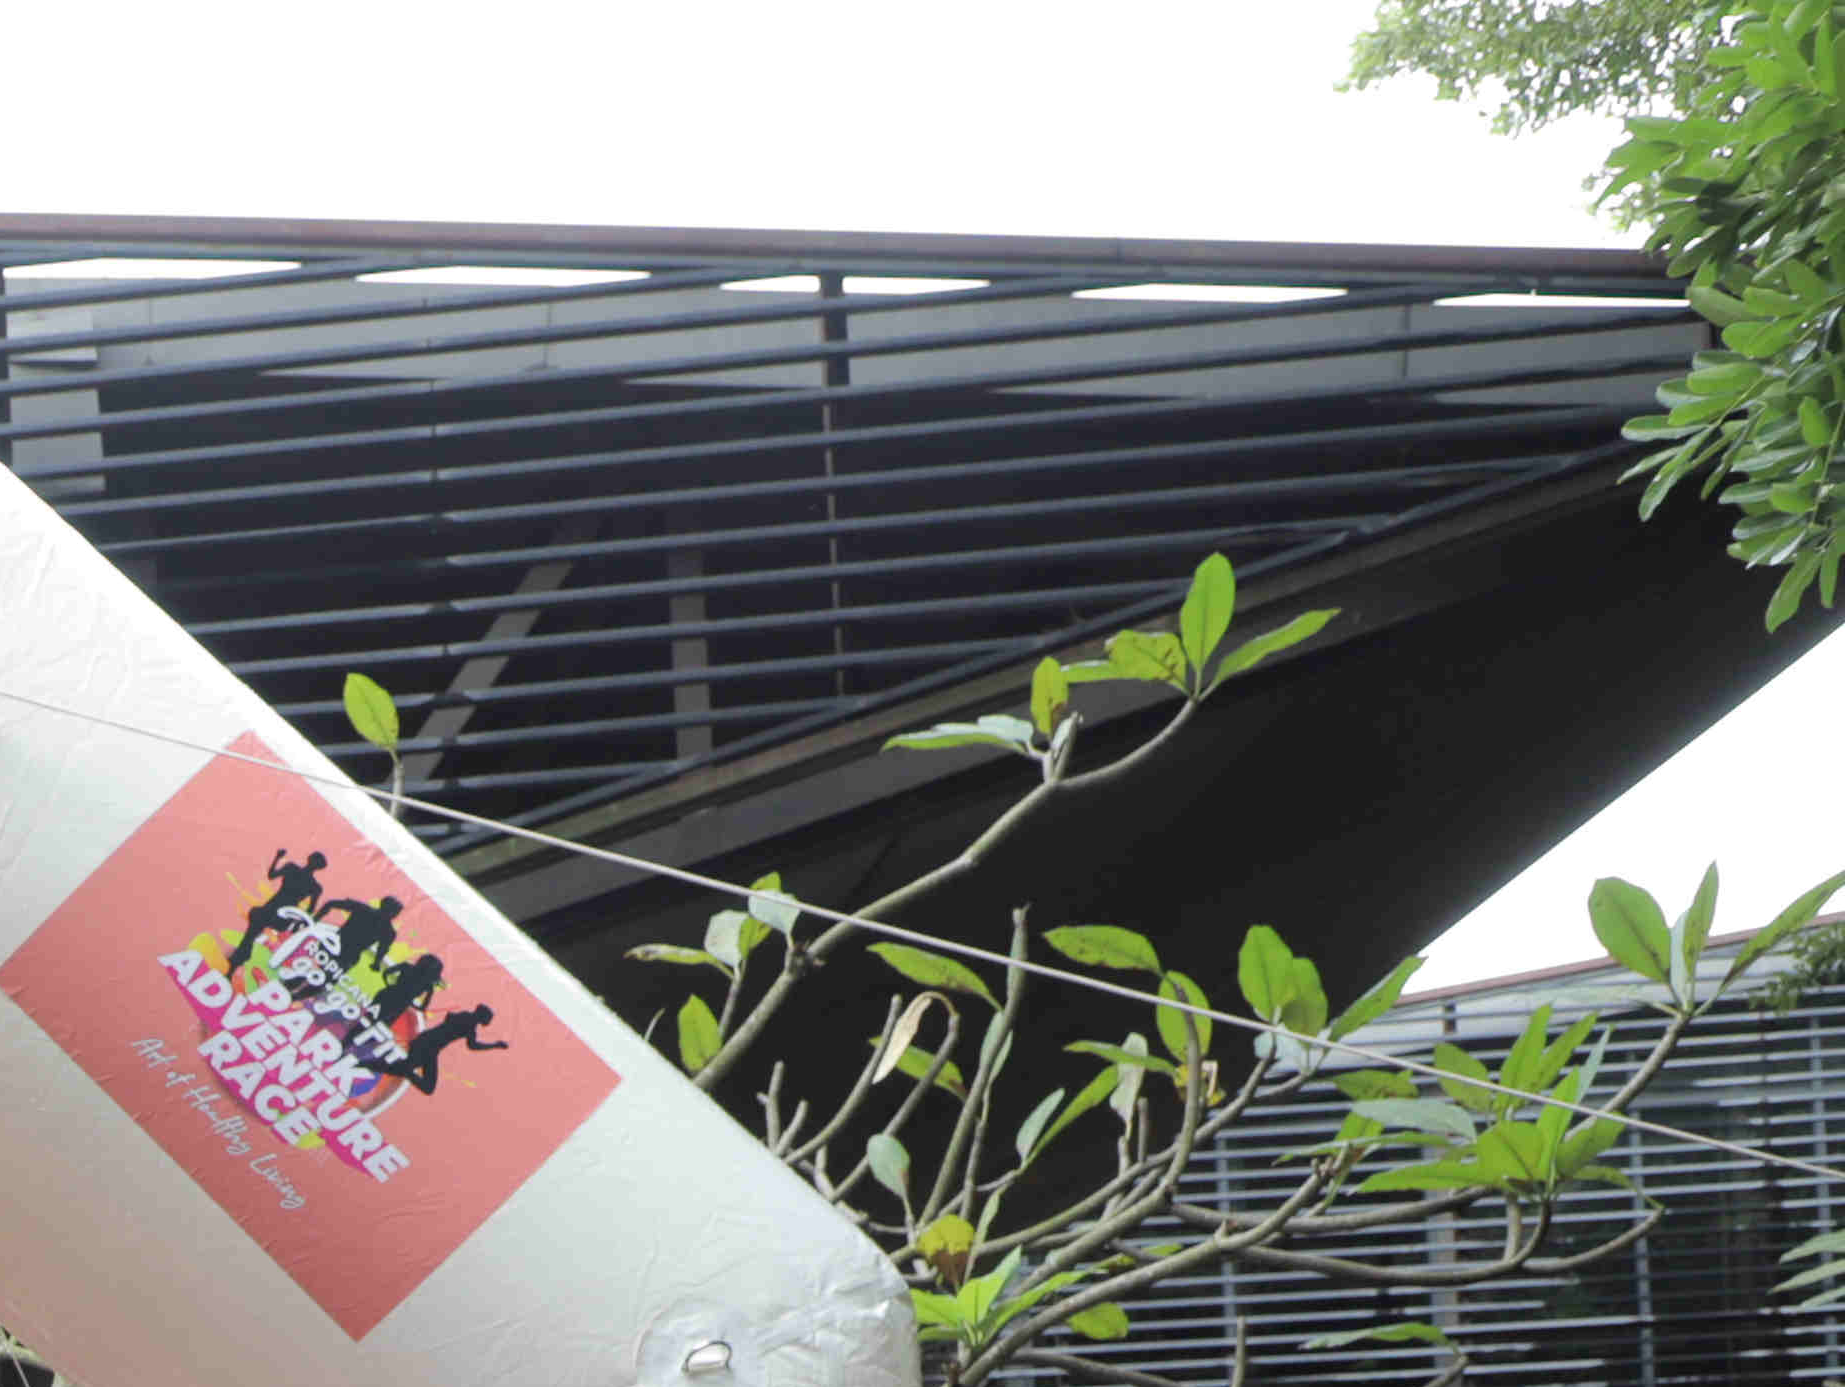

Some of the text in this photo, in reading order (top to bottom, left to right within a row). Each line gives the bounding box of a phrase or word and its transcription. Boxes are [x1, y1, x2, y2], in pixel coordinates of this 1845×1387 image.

[157, 949, 412, 1184] ADVENTURE
[197, 1030, 322, 1146] RACE
[248, 978, 377, 1098] PARK
[130, 1037, 307, 1211] Art of Healthy Living
